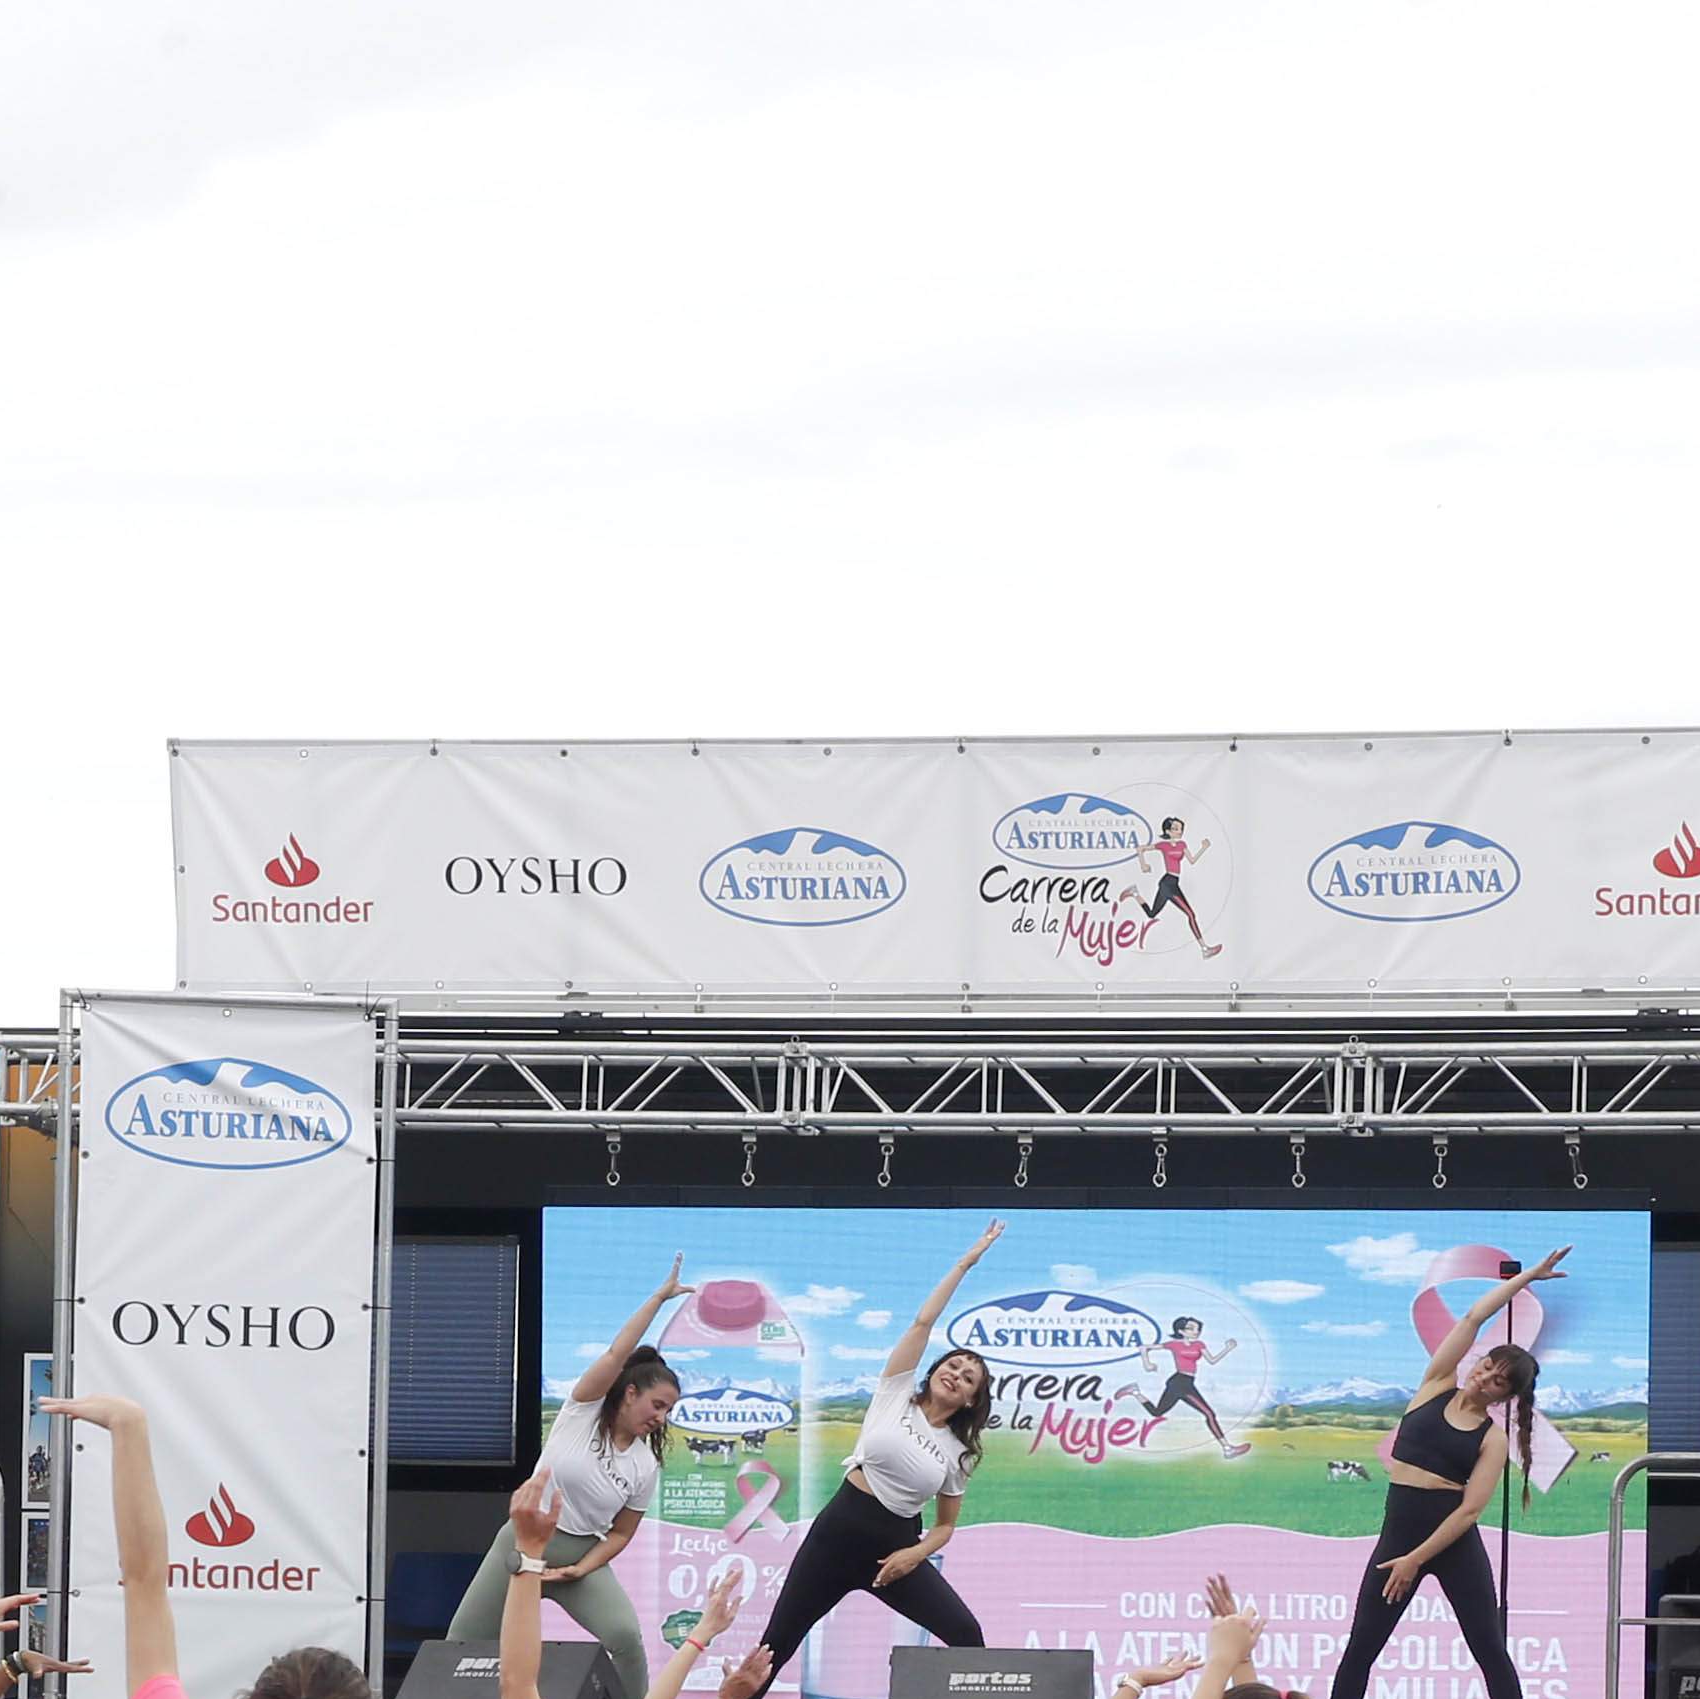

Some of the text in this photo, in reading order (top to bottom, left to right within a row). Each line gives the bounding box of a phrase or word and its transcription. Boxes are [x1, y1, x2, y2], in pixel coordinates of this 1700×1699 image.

[1005, 818, 1142, 851] ASTURIANA
[1028, 818, 1137, 828] CENTRAL LECHERA
[444, 854, 628, 896] OYSHO
[747, 860, 884, 871] CENTRAL LECHERA
[1356, 853, 1498, 868] CENTRAL LECHERA
[715, 858, 892, 901] ASTURIANA
[978, 865, 1111, 905] Carrera
[1323, 857, 1505, 899] ASTURIANA
[212, 894, 374, 925] Santander
[1011, 902, 1159, 967] de la Mujer
[123, 1092, 335, 1143] ASTURIANA
[162, 1092, 326, 1111] CENTRAL LECHERA
[111, 1300, 336, 1351] OYSHO
[964, 1317, 1145, 1348] ASTURIANA
[674, 1404, 785, 1424] ASTURIANA
[1009, 1400, 1167, 1464] la Mujer
[669, 1533, 729, 1557] Leche
[1120, 1591, 1347, 1621] CON LITRO
